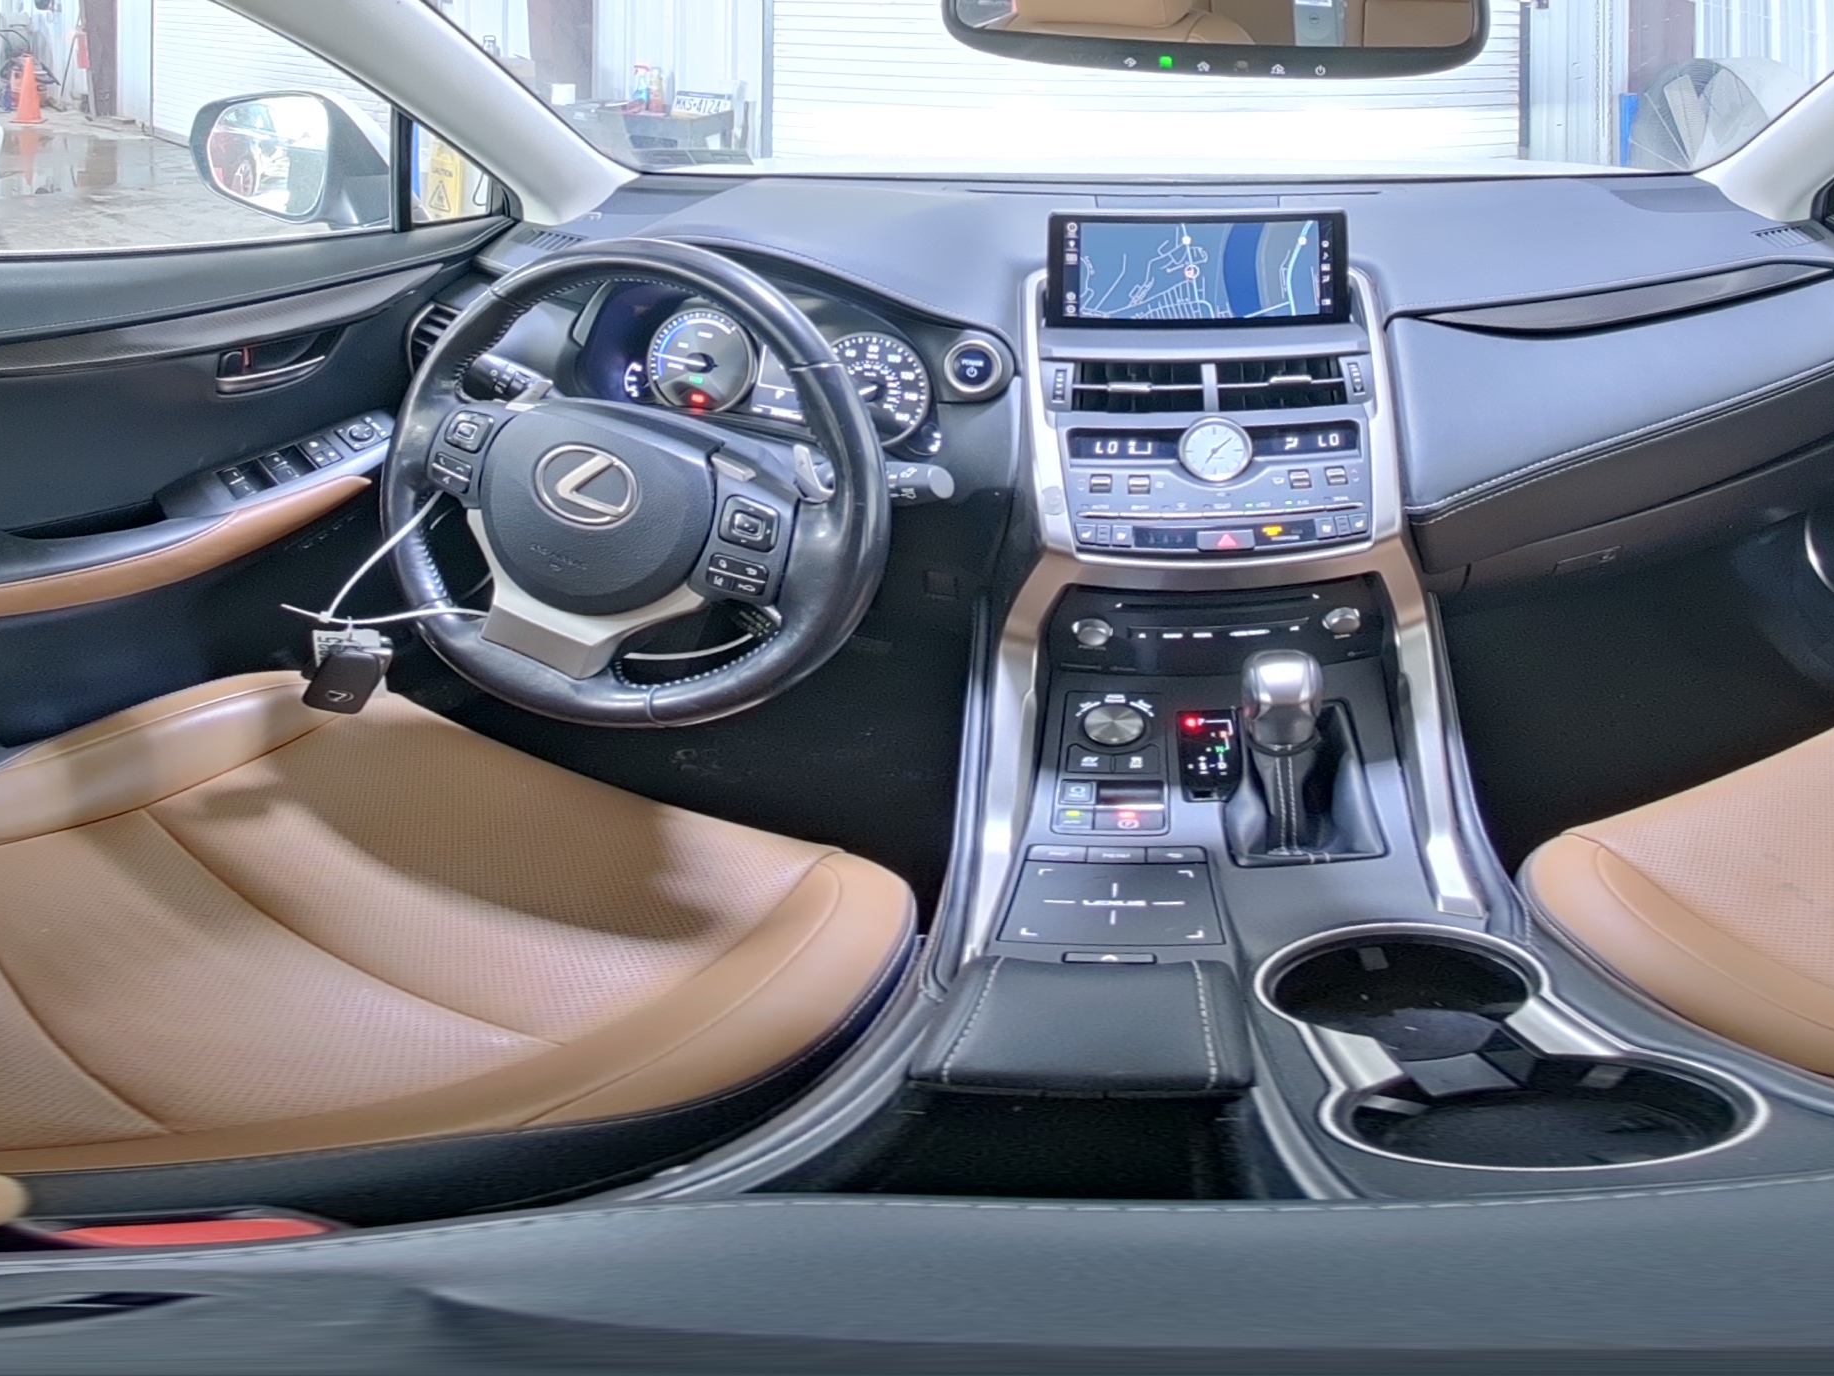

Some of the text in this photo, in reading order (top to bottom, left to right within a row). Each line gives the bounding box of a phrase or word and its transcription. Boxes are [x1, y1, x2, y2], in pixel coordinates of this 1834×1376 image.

[961, 358, 985, 368] POWER
[1317, 433, 1340, 447] LO
[1094, 441, 1119, 455] LO
